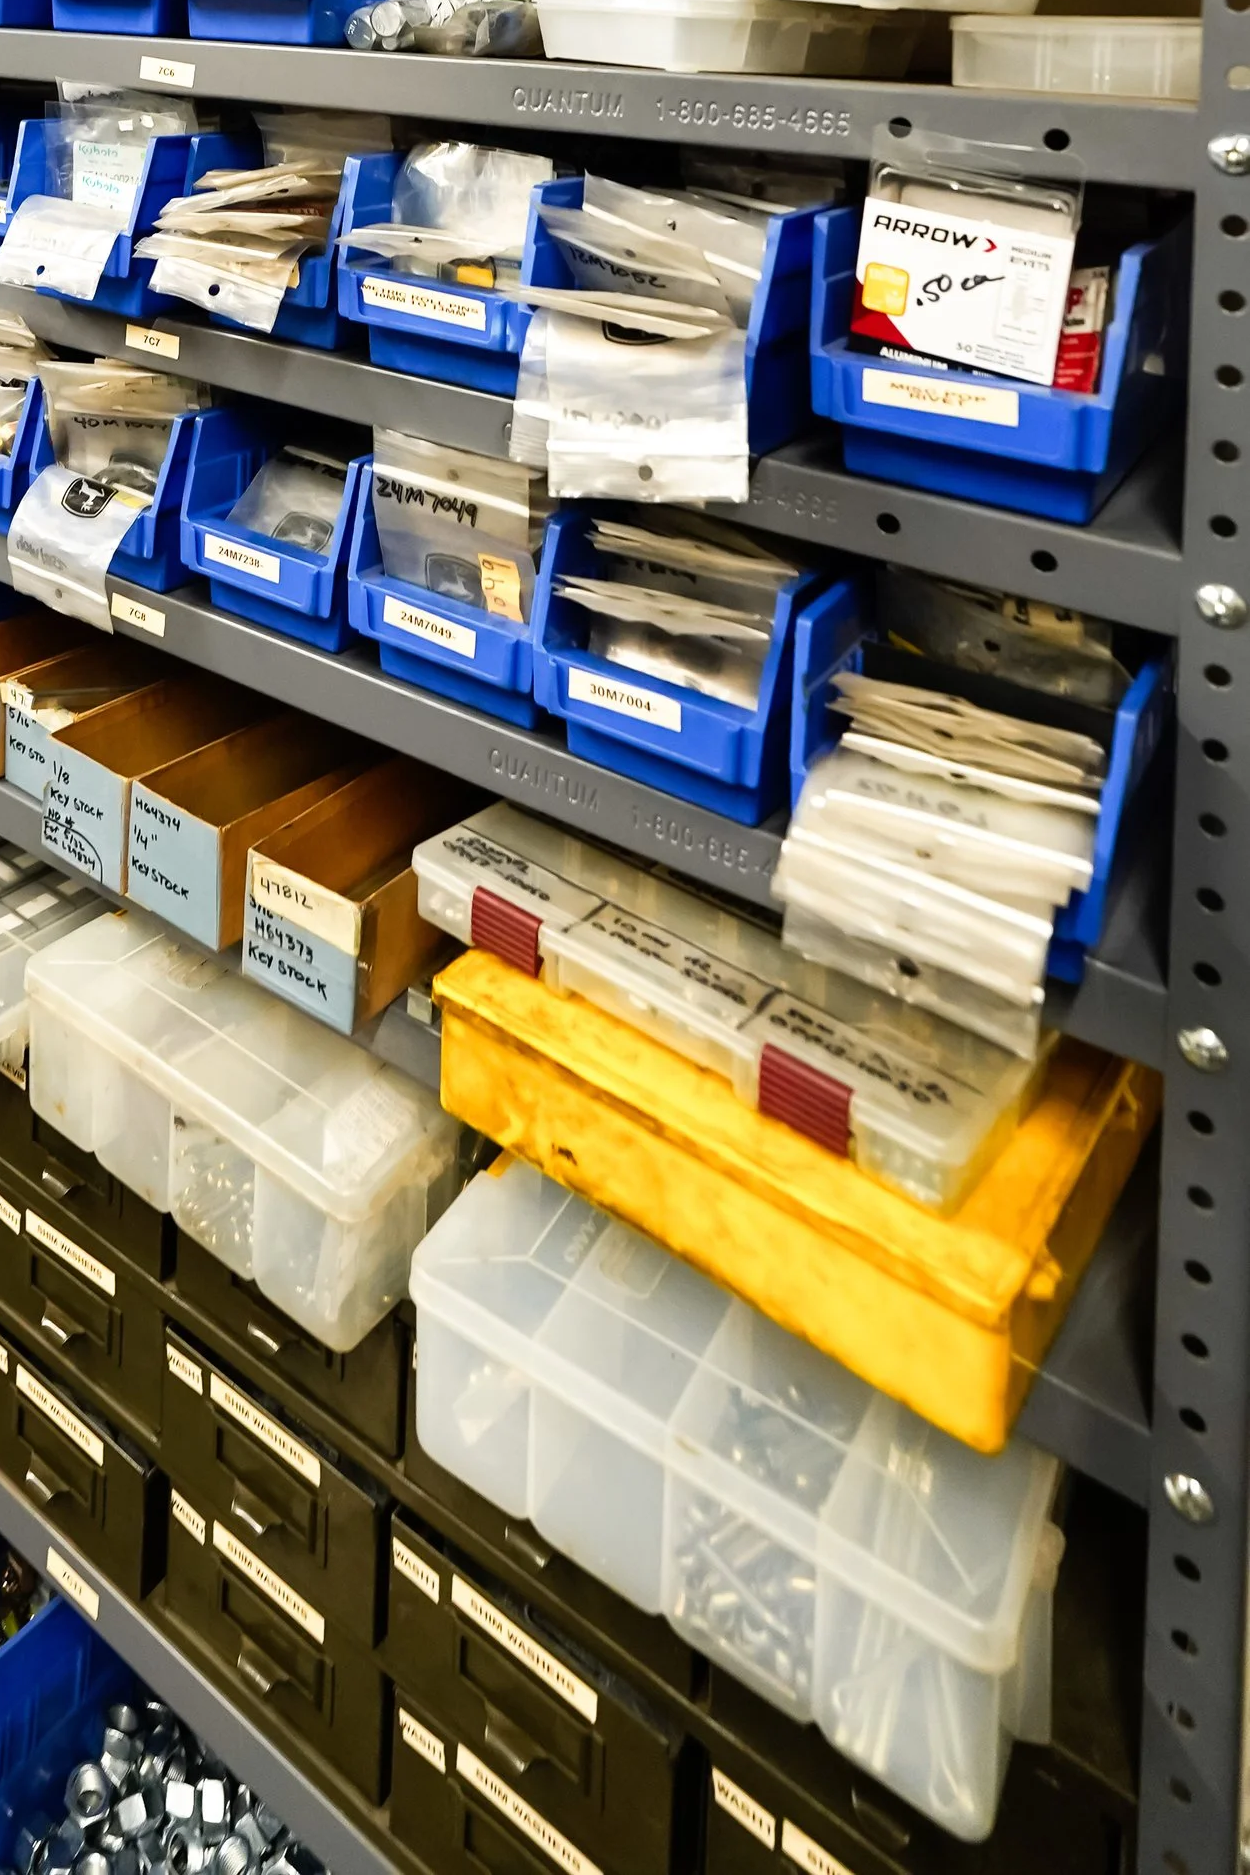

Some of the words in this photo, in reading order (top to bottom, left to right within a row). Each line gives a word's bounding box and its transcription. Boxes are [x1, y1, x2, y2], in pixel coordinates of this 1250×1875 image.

[158, 66, 175, 78] 7C6
[513, 87, 623, 119] QUANTUM
[656, 97, 851, 136] 1-800-685-4665
[79, 143, 119, 158] Kubota
[82, 175, 121, 194] Kubota
[873, 214, 978, 249] ARROW
[144, 334, 161, 347] 7C7
[375, 476, 479, 528] 24M7049
[129, 607, 147, 622] 7C8
[590, 682, 659, 715] 30M7004-
[53, 760, 70, 785] 1/8
[73, 797, 104, 821] STOCK
[151, 869, 190, 901] STOCK
[260, 876, 314, 910] 47812
[277, 958, 328, 1002] STOCK
[251, 1412, 305, 1466] WASHERS
[255, 1563, 308, 1622] WASHERS
[506, 1626, 576, 1697] WASHERS
[510, 1796, 582, 1874] WASHERS
